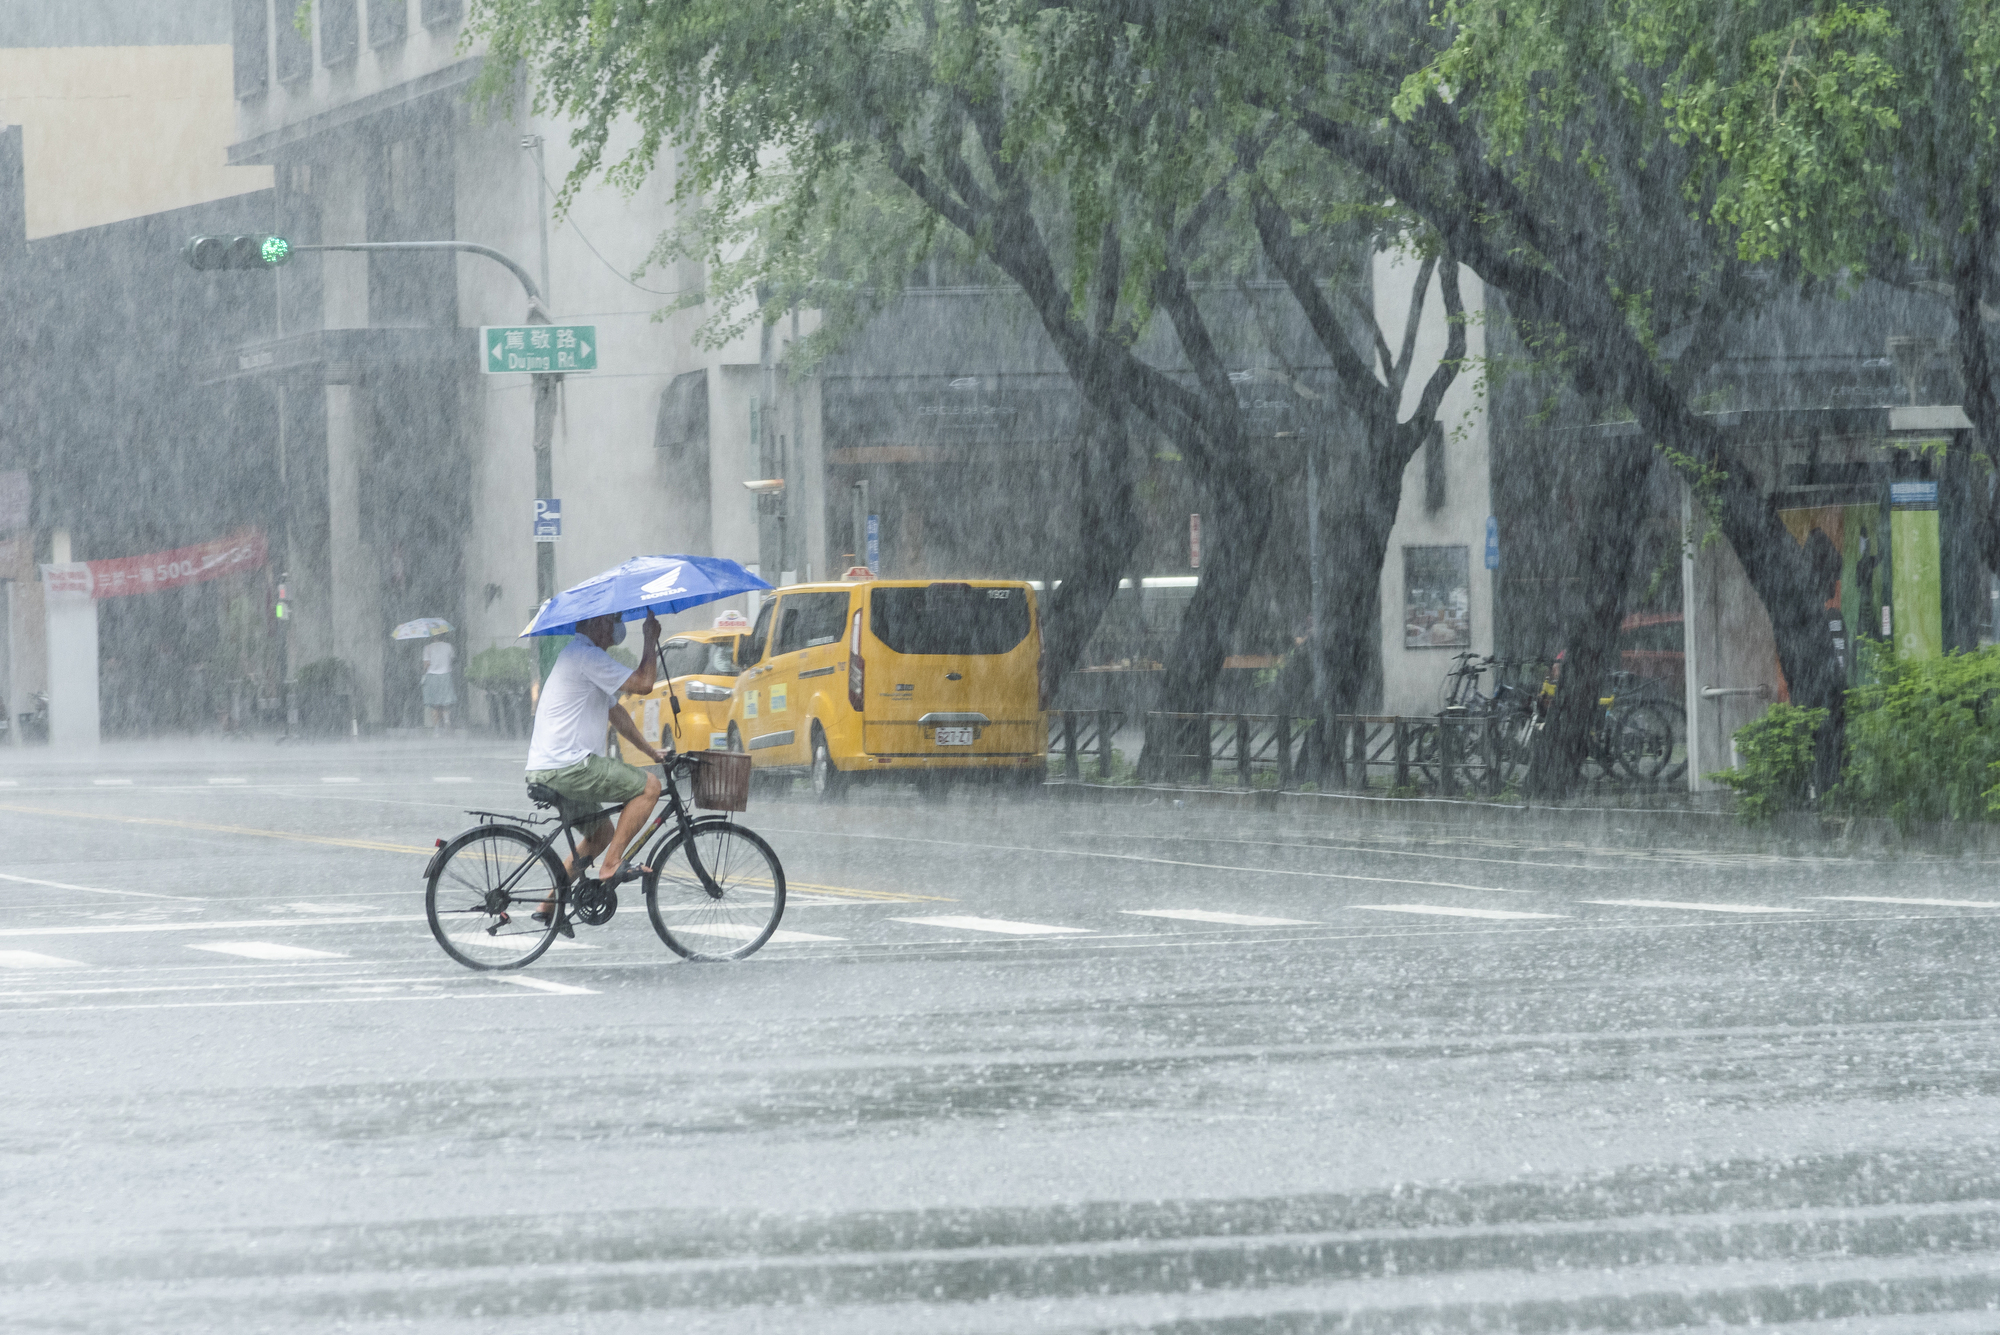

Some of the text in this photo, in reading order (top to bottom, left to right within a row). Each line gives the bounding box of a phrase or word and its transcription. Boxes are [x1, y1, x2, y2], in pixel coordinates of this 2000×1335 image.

[504, 329, 577, 350] 篤敬路
[533, 500, 548, 521] P
[640, 587, 687, 601] HONDA
